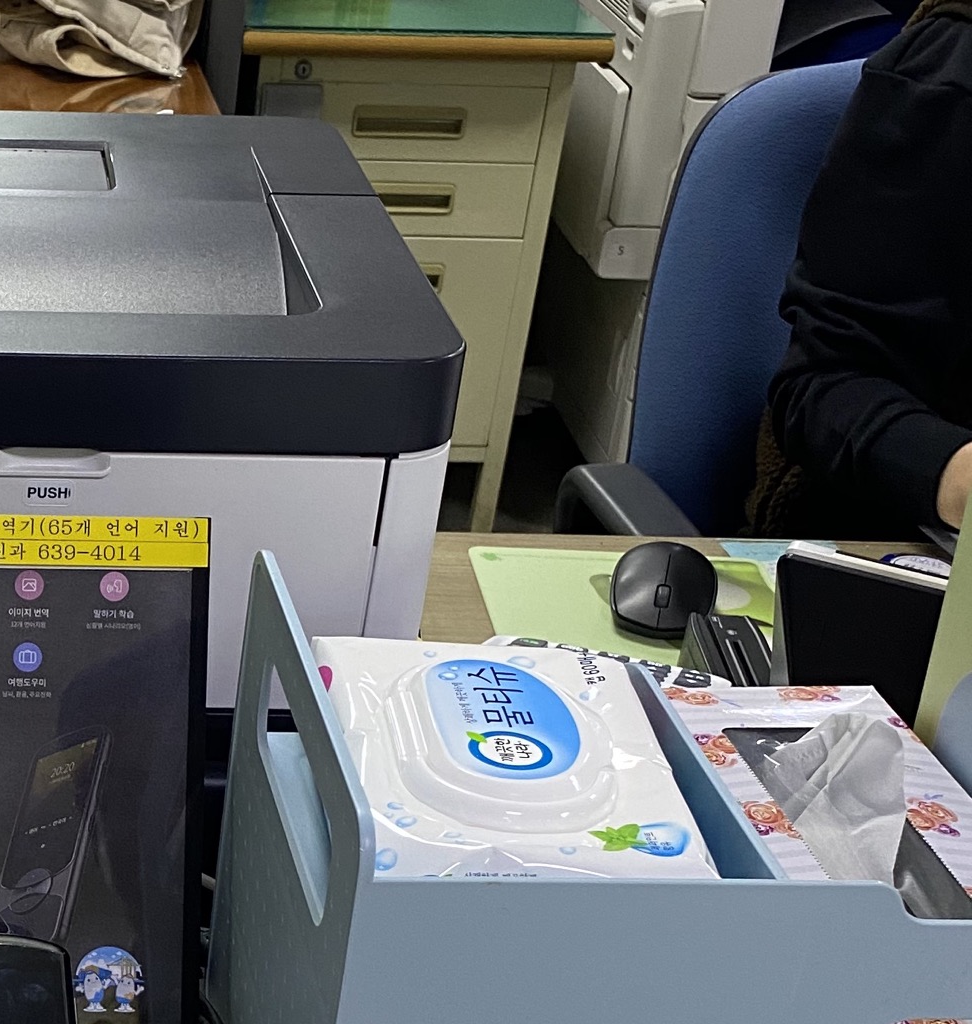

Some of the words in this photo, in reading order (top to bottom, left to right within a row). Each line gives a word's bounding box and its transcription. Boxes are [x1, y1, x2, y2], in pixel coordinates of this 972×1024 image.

[106, 519, 140, 537] 언어
[154, 520, 200, 539] 지원)
[38, 543, 142, 562] 639-4014
[8, 607, 32, 618] 이미지
[33, 607, 50, 618] 번역
[93, 609, 117, 619] 말하기
[118, 609, 135, 619] 학습
[7, 677, 47, 688] 여행도우미
[467, 666, 535, 728] 물티슈
[493, 737, 514, 762] 깨끗한
